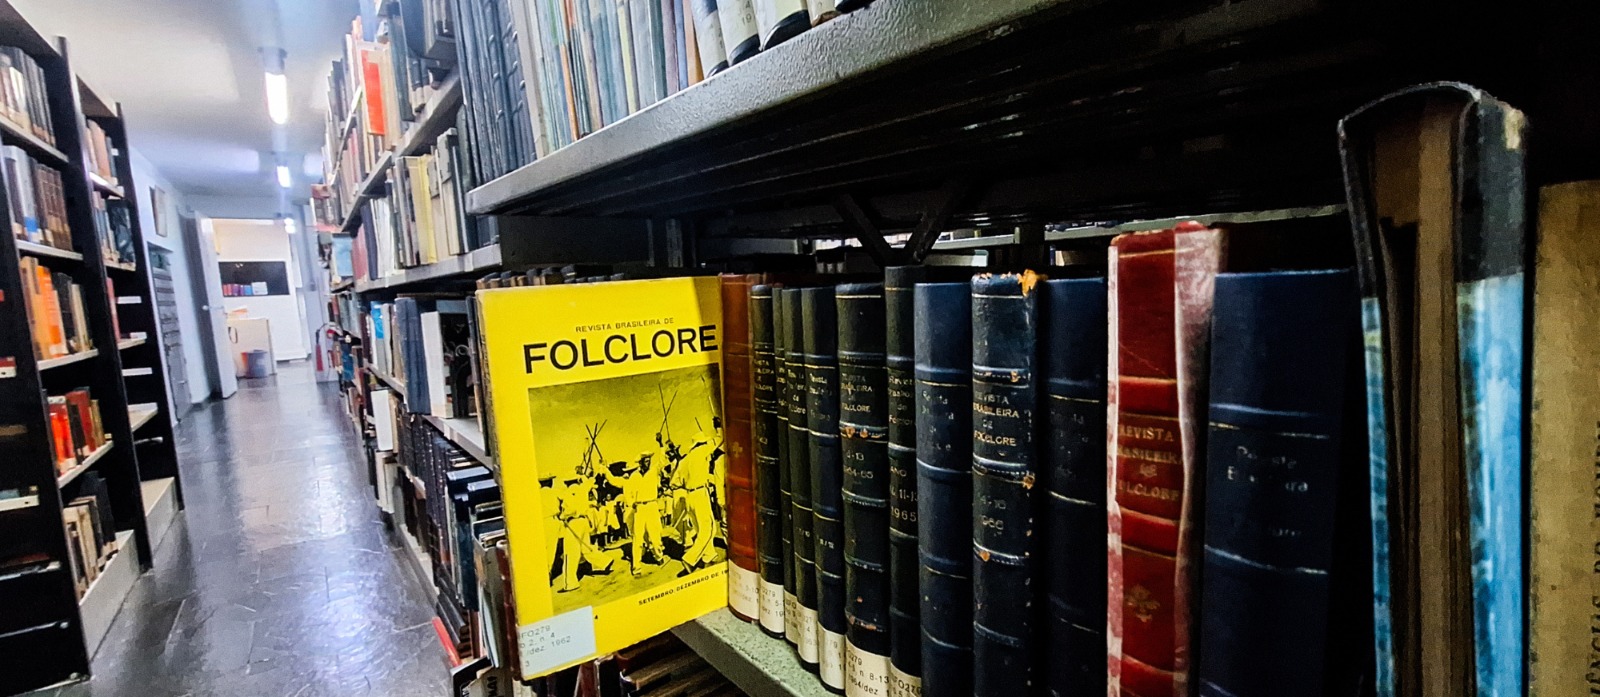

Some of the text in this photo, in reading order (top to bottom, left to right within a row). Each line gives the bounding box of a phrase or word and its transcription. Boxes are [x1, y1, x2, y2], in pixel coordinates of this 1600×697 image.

[575, 317, 675, 333] REVISTA BRASILEIRA DE
[523, 324, 718, 374] FOLCLORE
[890, 505, 917, 522] 1965
[638, 588, 674, 606] SETEMBRO
[676, 575, 709, 592] DEZEMBRO
